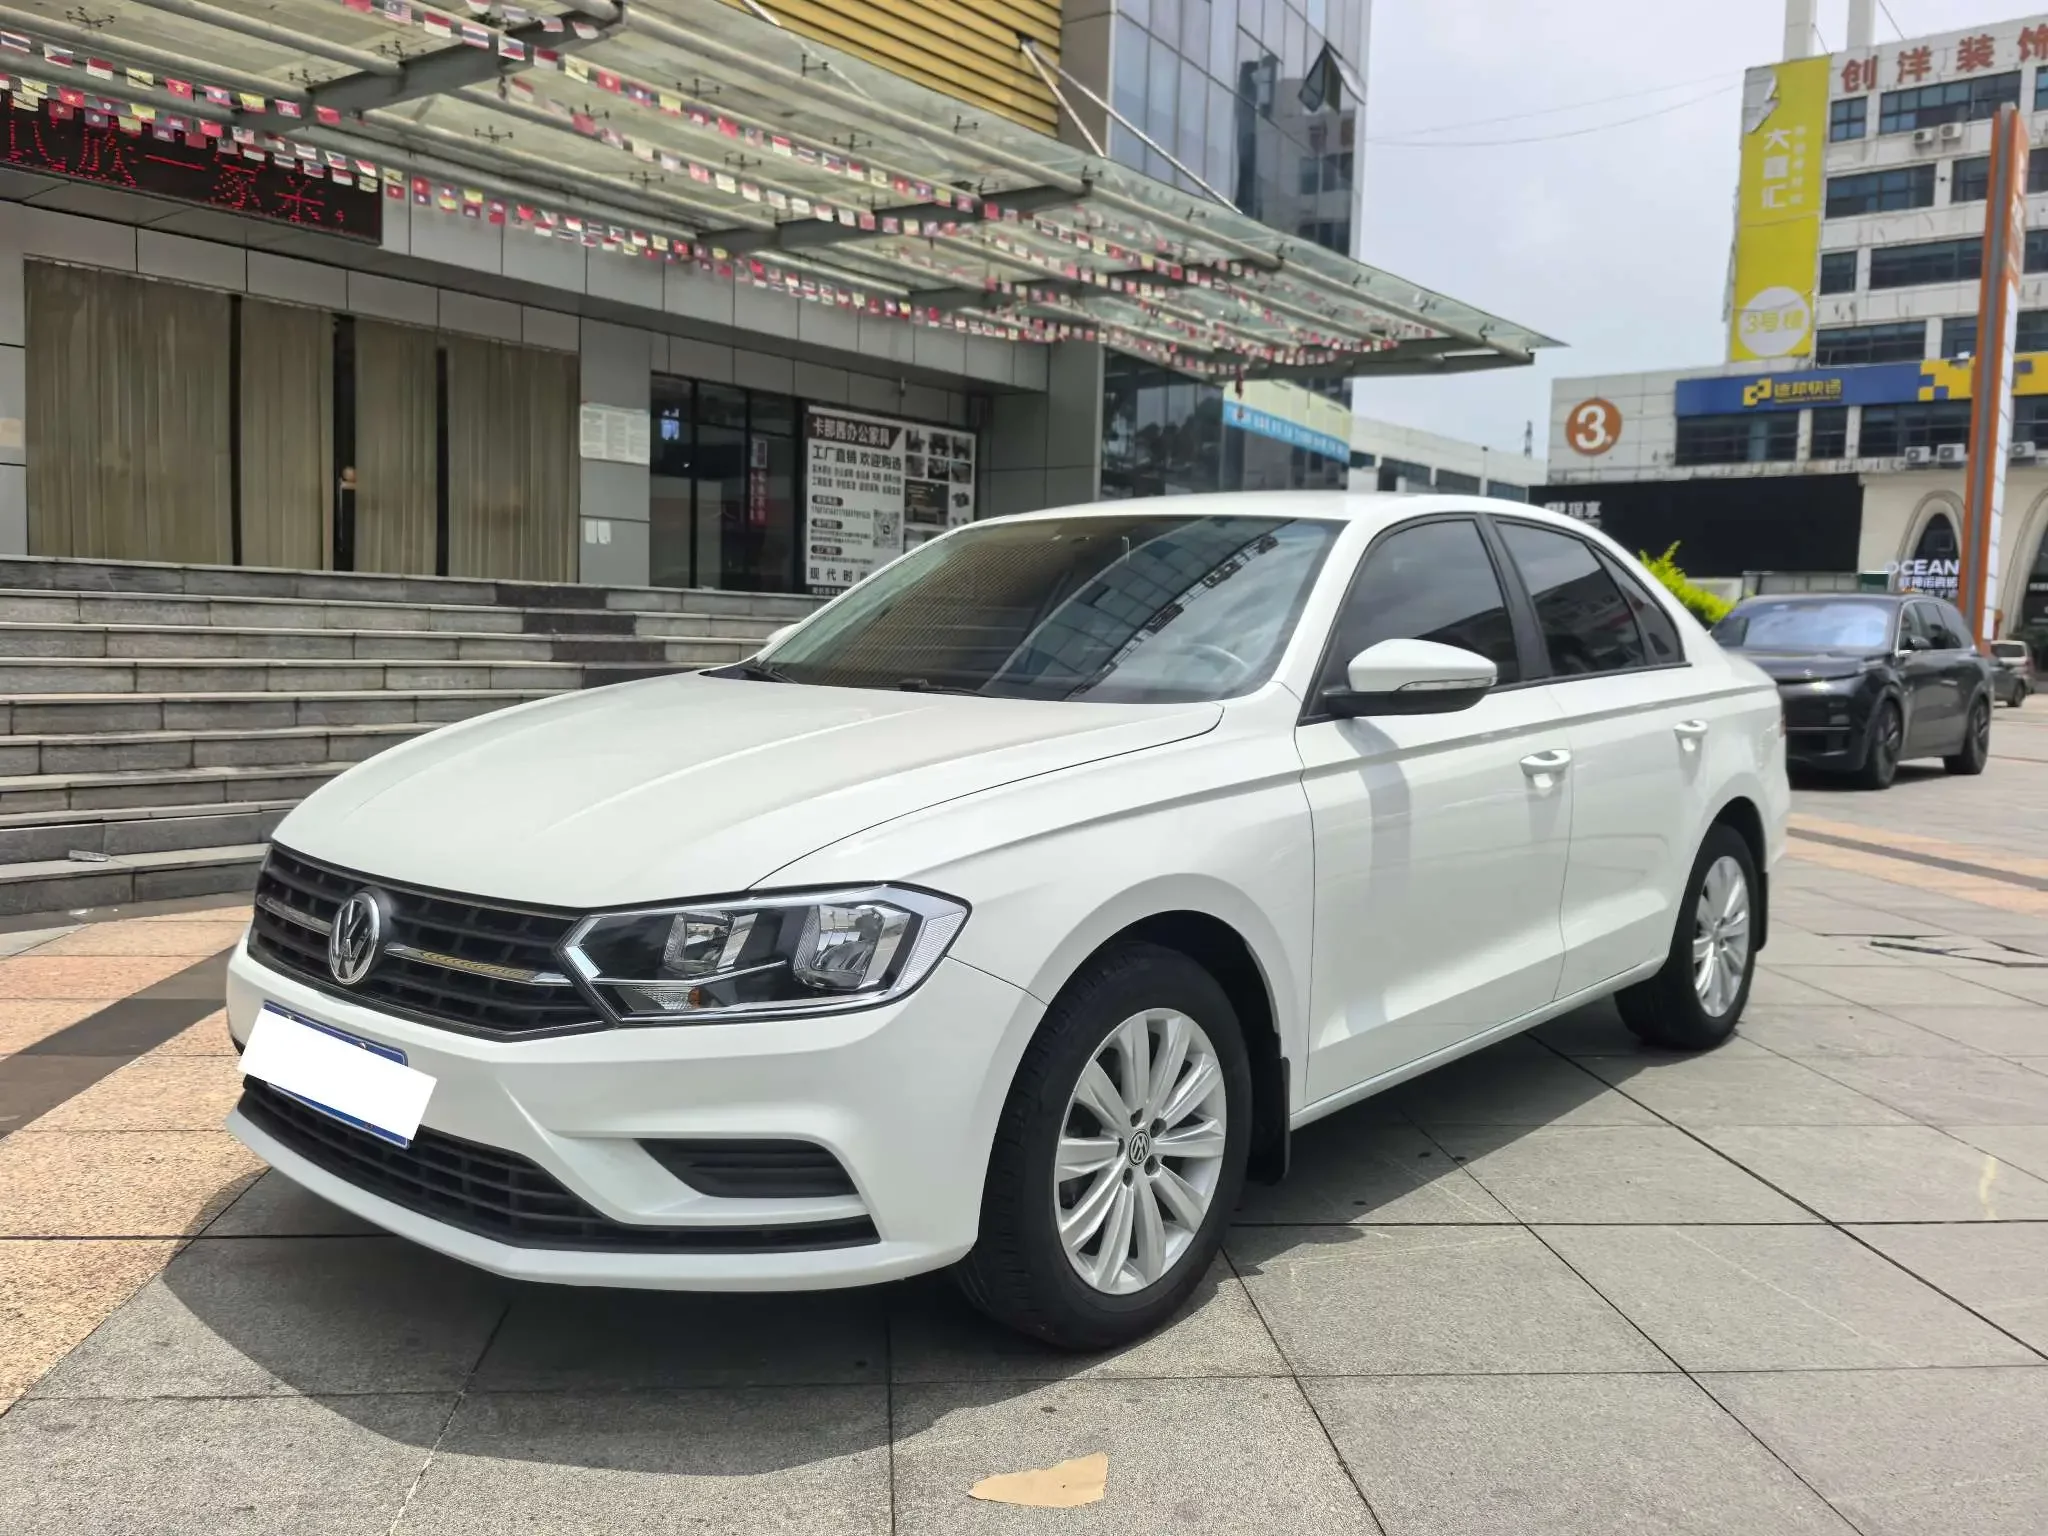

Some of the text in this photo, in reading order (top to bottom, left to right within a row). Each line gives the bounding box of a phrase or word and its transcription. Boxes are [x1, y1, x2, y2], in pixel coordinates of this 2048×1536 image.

[1841, 23, 2048, 93] 创洋装饰
[1575, 405, 1607, 449] 3
[812, 445, 857, 465] 工厂直销
